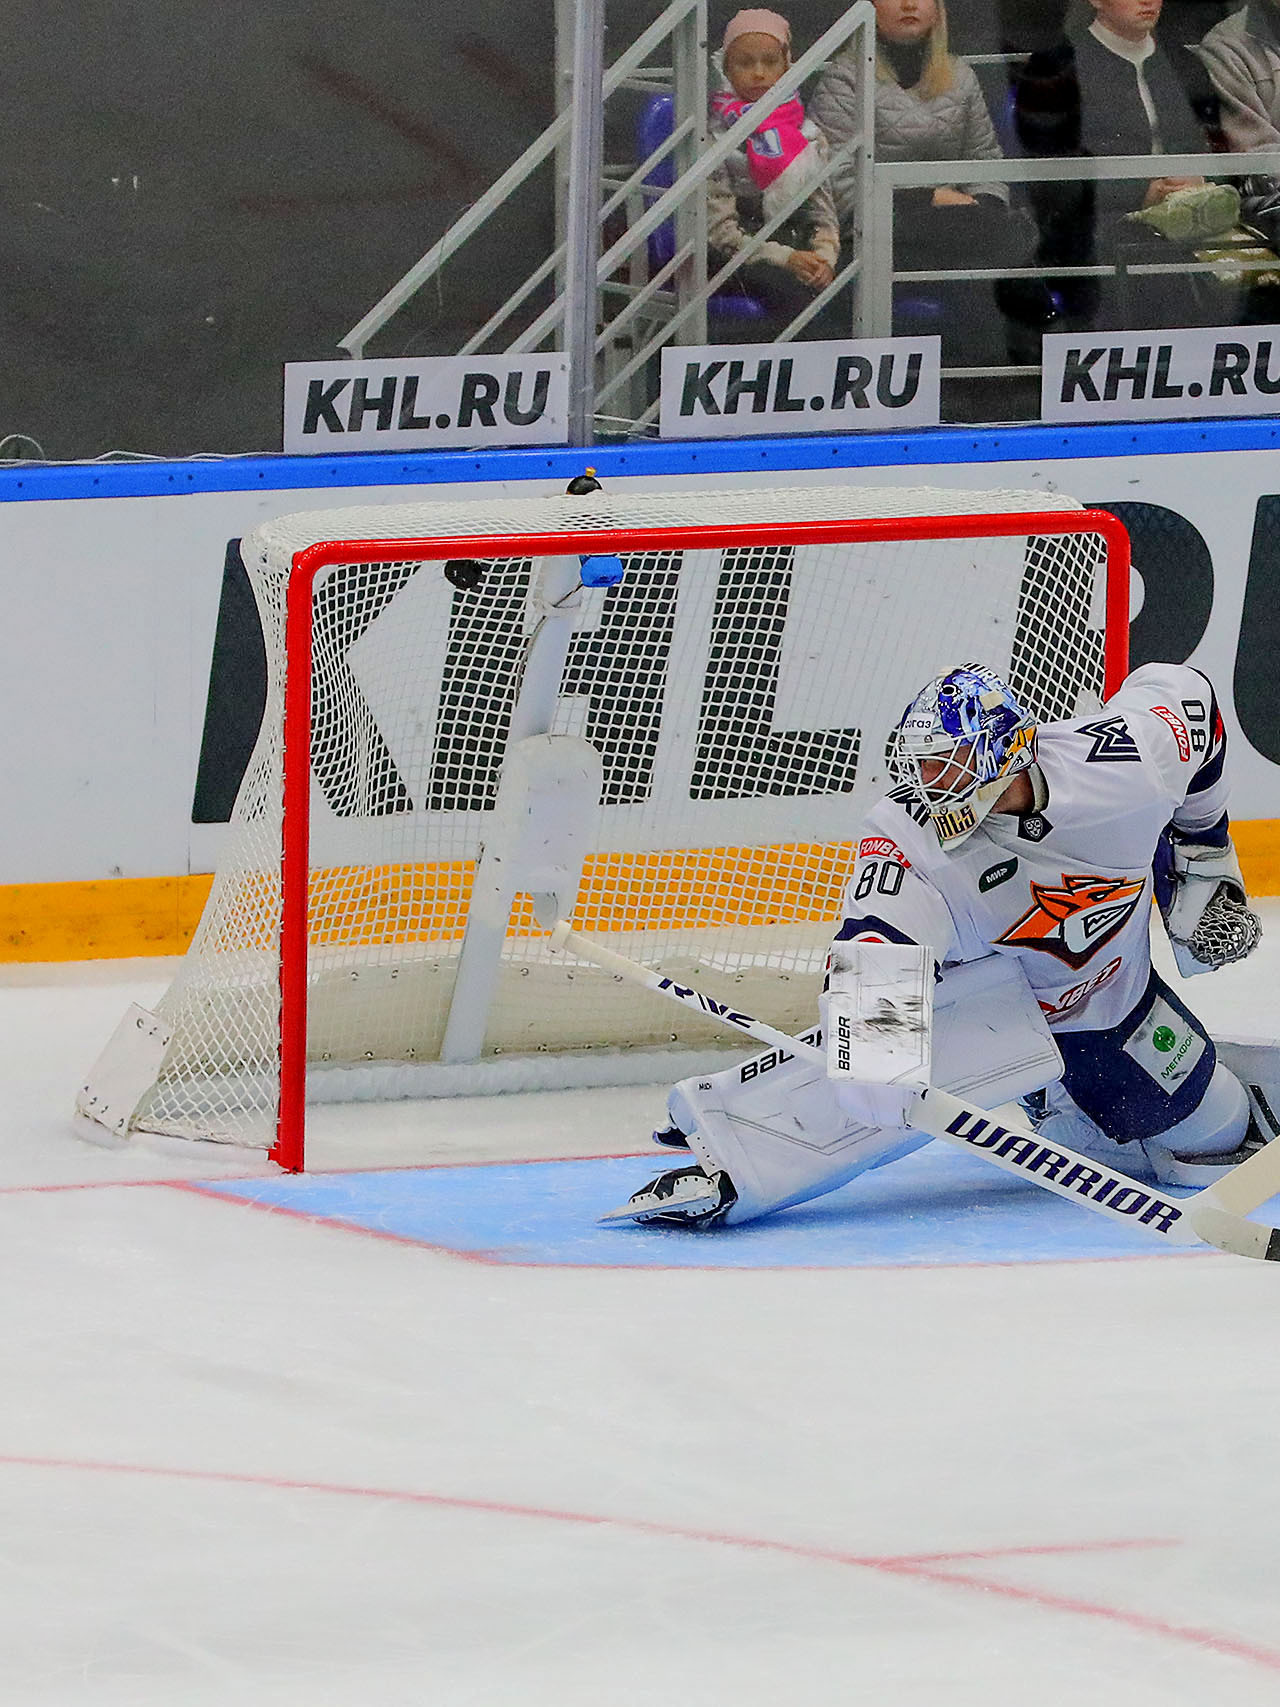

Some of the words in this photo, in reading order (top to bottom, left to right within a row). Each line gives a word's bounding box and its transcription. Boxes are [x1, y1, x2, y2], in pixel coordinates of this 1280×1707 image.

[302, 370, 551, 434] KHL.RU
[681, 353, 923, 416] KHL.RU
[1153, 708, 1190, 760] FONBET
[1181, 700, 1206, 752] 80
[854, 860, 906, 901] 80
[986, 867, 1008, 884] МИР
[838, 1016, 851, 1072] BAUER
[1160, 1030, 1195, 1079] МЕГАФОН
[944, 1110, 1183, 1234] WARRIOR
